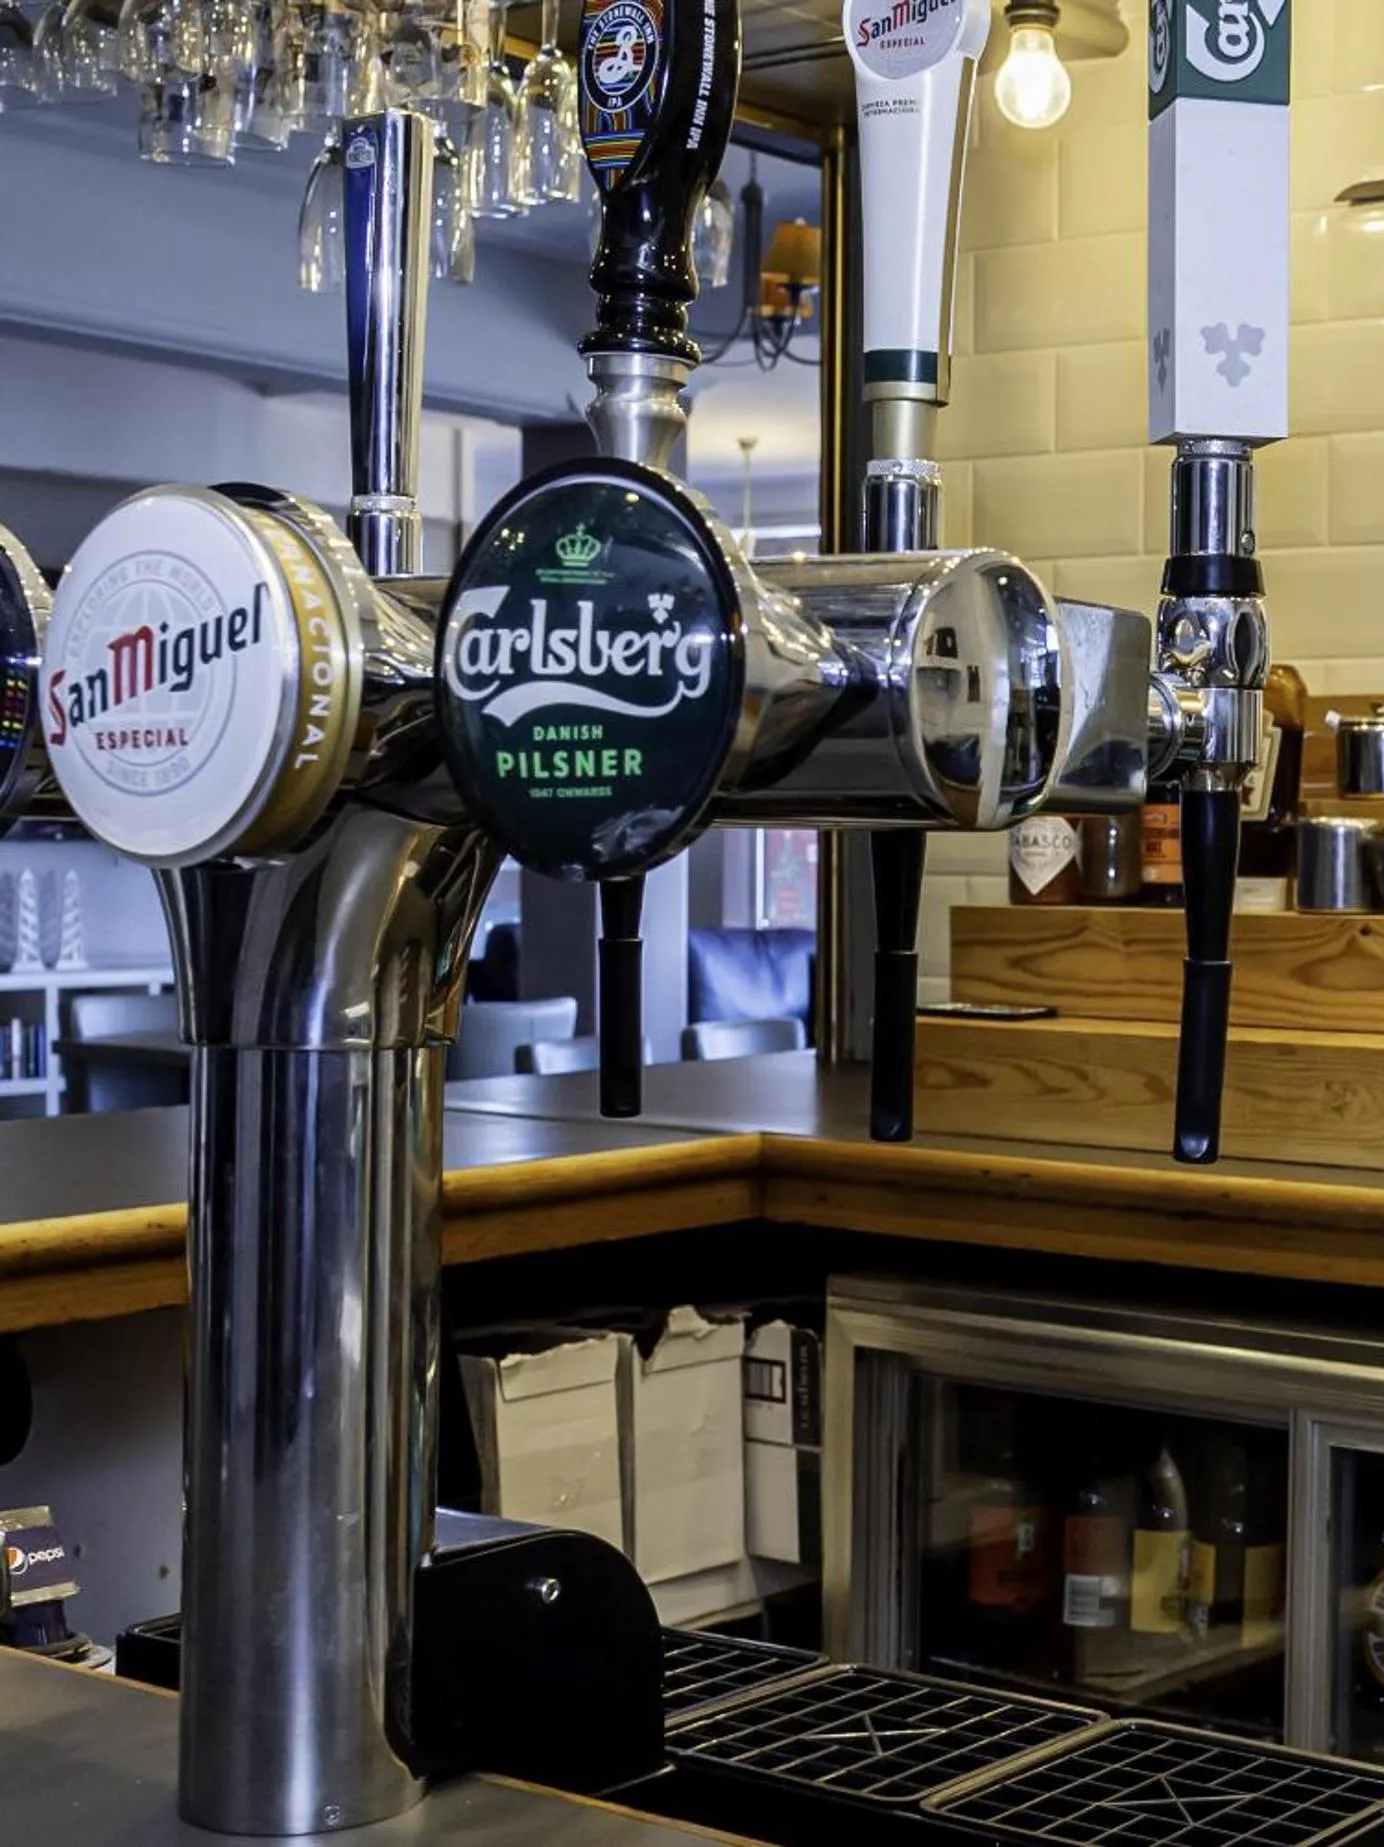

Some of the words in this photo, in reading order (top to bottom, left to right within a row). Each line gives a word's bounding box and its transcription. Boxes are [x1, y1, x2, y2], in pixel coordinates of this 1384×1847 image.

[704, 0, 716, 17] HE
[588, 30, 599, 50] THE
[599, 6, 645, 28] STONEWALL
[880, 37, 925, 49] ESPECIAL
[699, 18, 716, 97] STONEWALL
[607, 97, 622, 108] IPA
[692, 98, 708, 126] INN
[686, 126, 702, 149] IPA
[134, 560, 163, 577] THE
[170, 563, 216, 611] WORLD
[446, 585, 712, 701] Carlsberg
[95, 728, 189, 750] ESPECIAL
[533, 725, 603, 741] DANISH
[496, 748, 643, 779] PILSNER
[1014, 834, 1072, 850] ABASCO
[28, 1546, 65, 1565] pepsi
